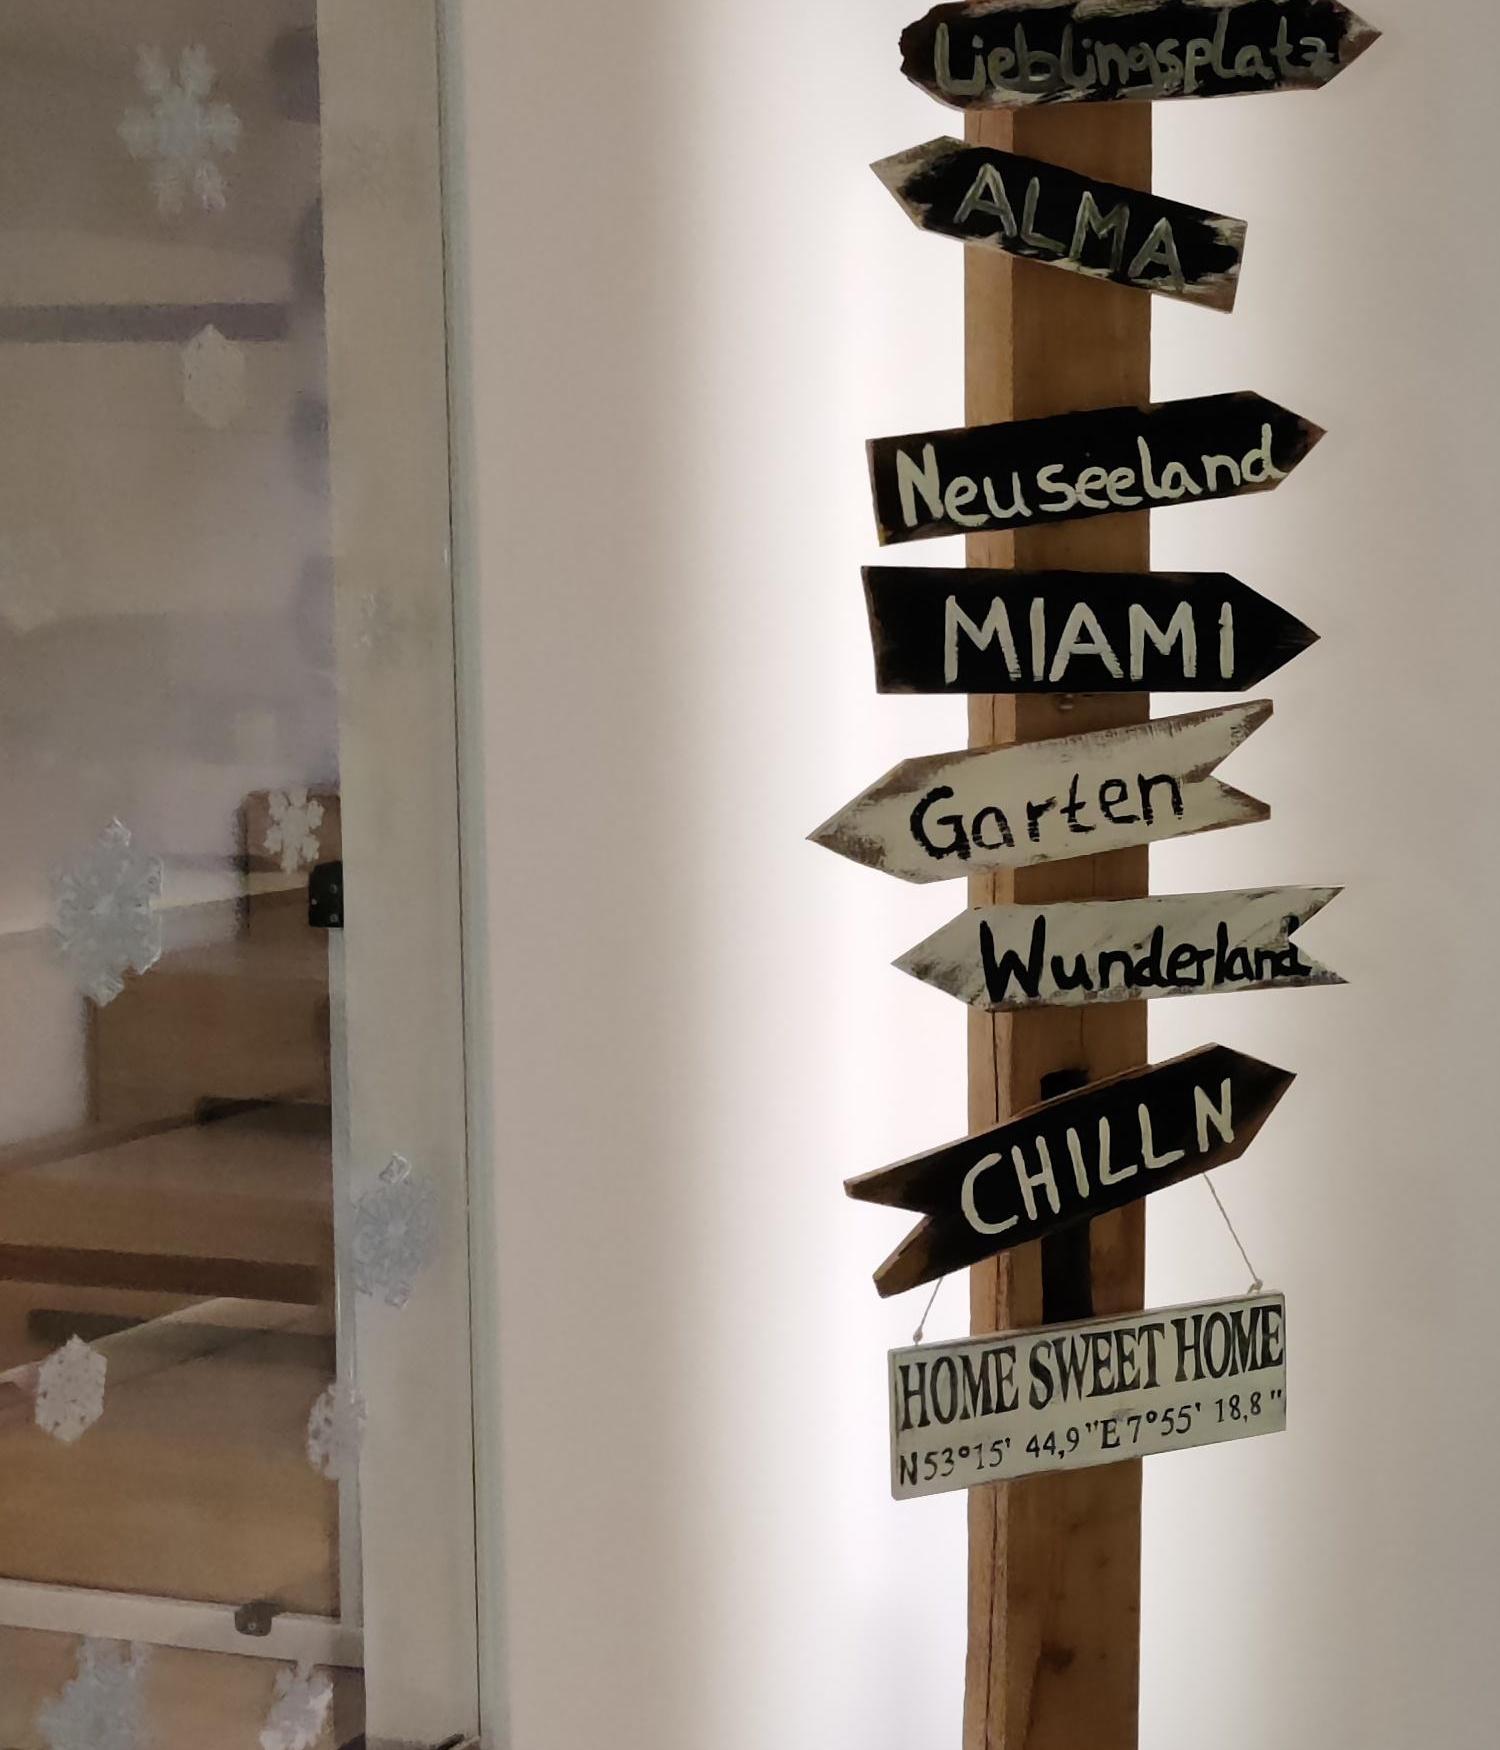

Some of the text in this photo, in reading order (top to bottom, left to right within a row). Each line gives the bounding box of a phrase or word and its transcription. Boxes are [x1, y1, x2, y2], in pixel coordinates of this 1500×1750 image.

[933, 6, 1336, 95] Lieblingsplatz
[953, 163, 1186, 292] ALMA
[896, 423, 1289, 527] Neuseeland
[943, 595, 1236, 685] MIAMI
[909, 773, 1184, 860] Garten
[979, 914, 1313, 1003] Wunderland
[898, 1302, 1286, 1432] HOME SWEET HOME
